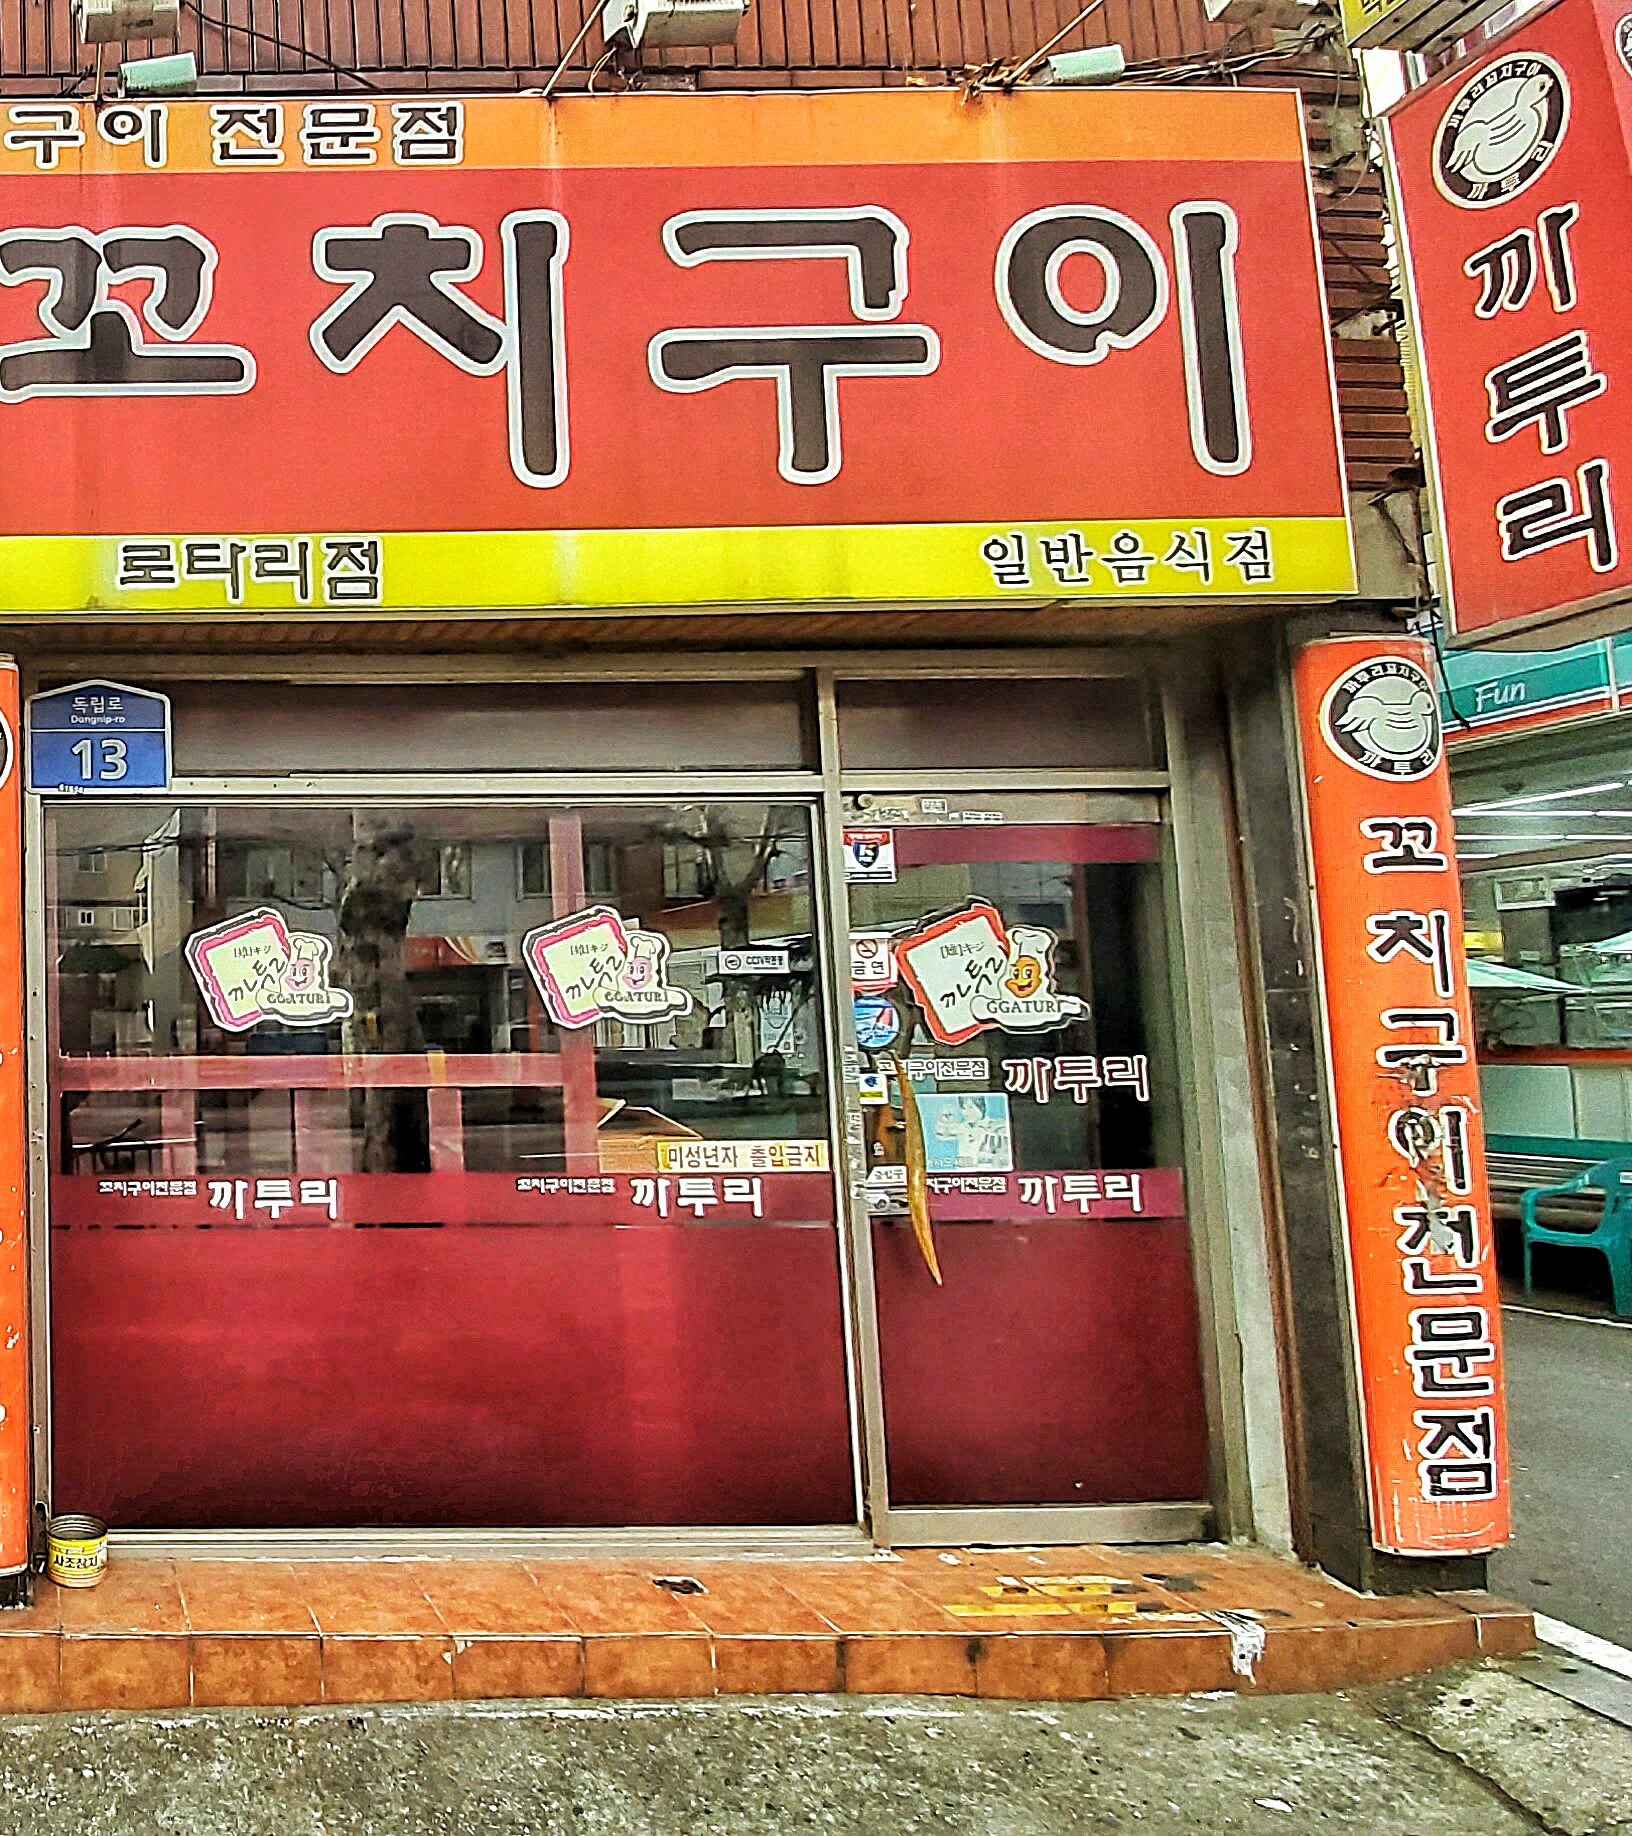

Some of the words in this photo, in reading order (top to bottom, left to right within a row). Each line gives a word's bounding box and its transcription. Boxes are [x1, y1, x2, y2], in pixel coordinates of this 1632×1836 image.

[210, 101, 464, 167] 전문점
[1464, 202, 1620, 574] 까투리
[116, 536, 385, 605] 로타리점
[981, 530, 1278, 588] 일반음식점
[72, 696, 124, 714] 독립로
[1475, 681, 1527, 713] Fun
[71, 738, 128, 781] 13
[986, 999, 1062, 1014] GGATURI
[1002, 1055, 1150, 1102] 까투리
[668, 1145, 739, 1169] 미성년자
[749, 1145, 820, 1169] 출입금지
[99, 1180, 197, 1196] 꼬치구이전문점
[207, 1179, 338, 1220] 까투리
[517, 1178, 616, 1194] 꼬치구이전문점
[630, 1176, 763, 1218] 까투리
[1020, 1175, 1143, 1213] 까투리
